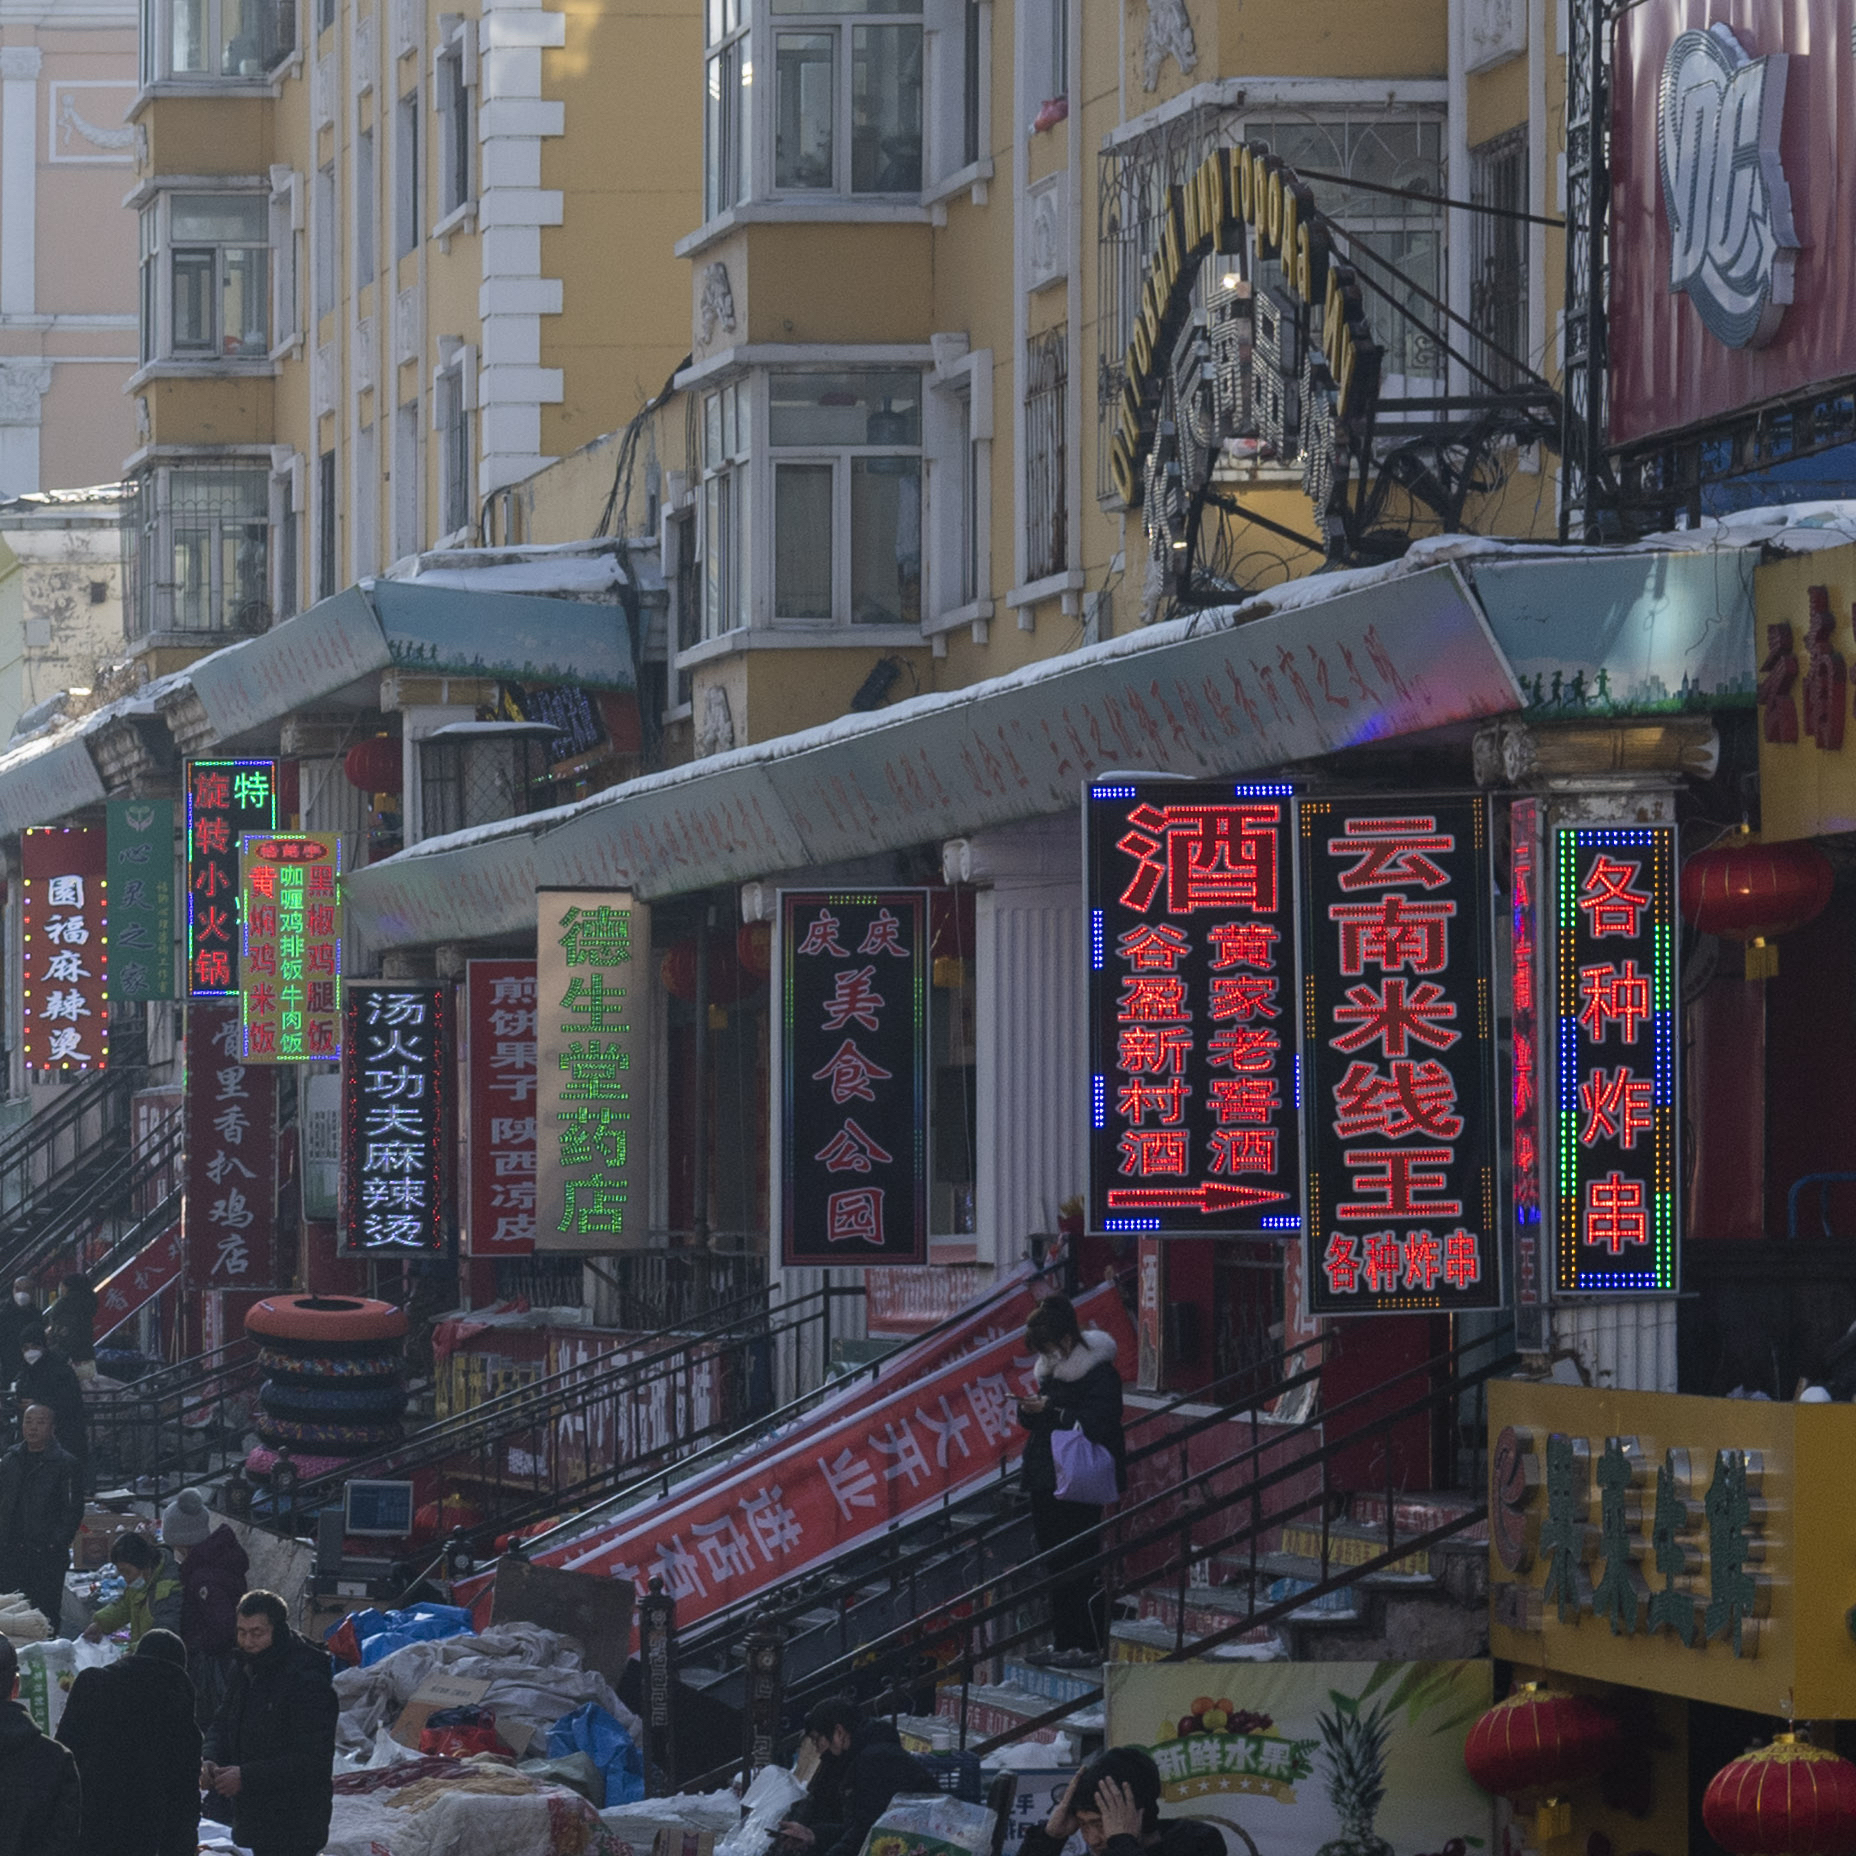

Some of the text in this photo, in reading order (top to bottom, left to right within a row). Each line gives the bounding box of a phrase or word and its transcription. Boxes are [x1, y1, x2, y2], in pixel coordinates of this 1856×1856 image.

[194, 772, 230, 986] 旋转小火锅
[233, 772, 269, 810] 特
[1116, 803, 1281, 916] 酒
[116, 843, 155, 995] 心灵之家
[248, 865, 277, 1054] 黄焖鸡米饭
[306, 865, 335, 1054] 黑椒鸡腿饭
[797, 909, 910, 958] 庆庆
[1328, 816, 1464, 1220] 云南米线王
[362, 992, 427, 1248] 汤火功夫麻辣烫
[557, 906, 631, 1235] 德生堂药店
[812, 965, 894, 1246] 美食公园
[1117, 922, 1191, 1177] 谷盈新村酒
[1208, 922, 1282, 1176] 黄家老窖酒
[1580, 856, 1652, 1254] 各种炸串
[1324, 1229, 1479, 1293] 各种炸串
[1154, 1737, 1293, 1779] 新鲜水果
